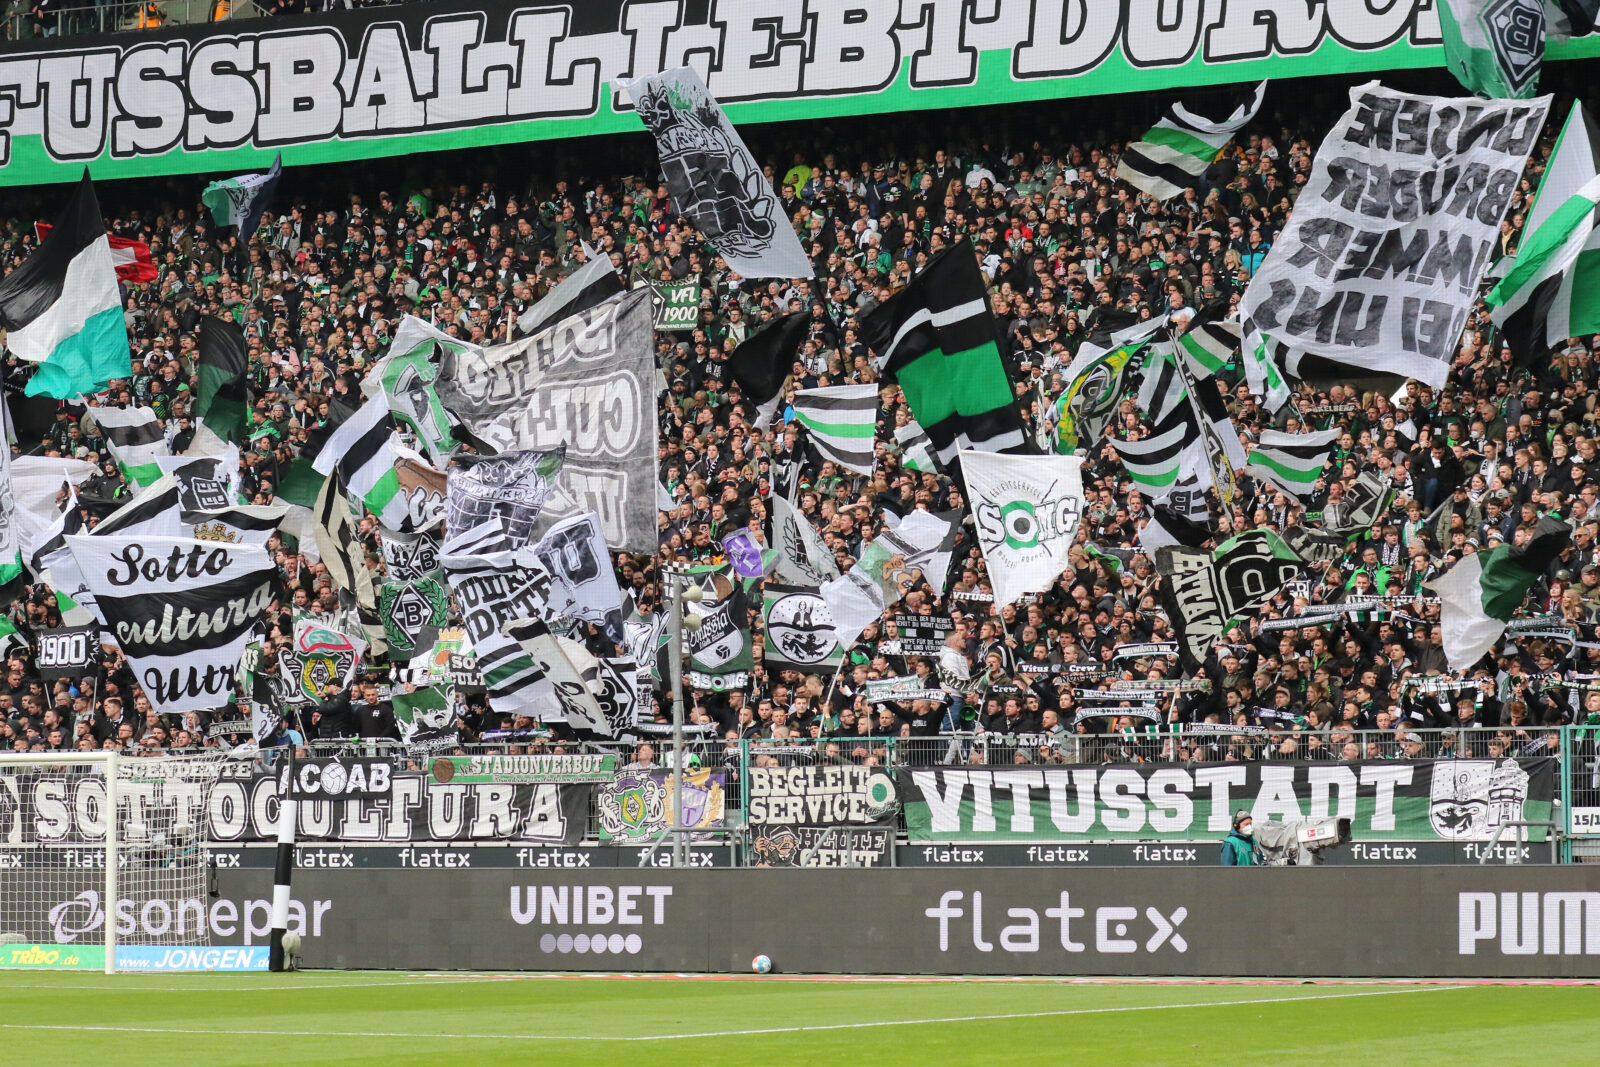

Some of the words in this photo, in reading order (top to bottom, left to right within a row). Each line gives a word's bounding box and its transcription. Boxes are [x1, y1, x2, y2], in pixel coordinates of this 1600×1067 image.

[672, 286, 697, 303] VFL
[664, 306, 698, 321] 1900
[107, 543, 233, 586] Sotto
[116, 580, 276, 645] cultura
[40, 633, 86, 666] 1900
[1021, 664, 1049, 672] Vitus
[1069, 664, 1097, 672] Crew
[118, 760, 254, 780] SCENDENTE
[471, 755, 604, 775] STADIONVERBOT
[749, 765, 871, 797] BEGLEIT
[749, 793, 866, 824] SERVICE
[912, 765, 1414, 833] VITUSSTADT
[398, 848, 470, 868] flatex
[516, 848, 590, 867] flatex
[637, 848, 714, 867] flaex
[923, 847, 984, 863] flatex
[1026, 846, 1089, 862] flatex
[1133, 845, 1197, 861] flatex
[1350, 843, 1417, 860] flatex
[510, 885, 673, 925] UNIBET
[116, 898, 332, 946] sonepar
[924, 890, 1189, 954] flatex
[154, 949, 254, 969] JONGEN
